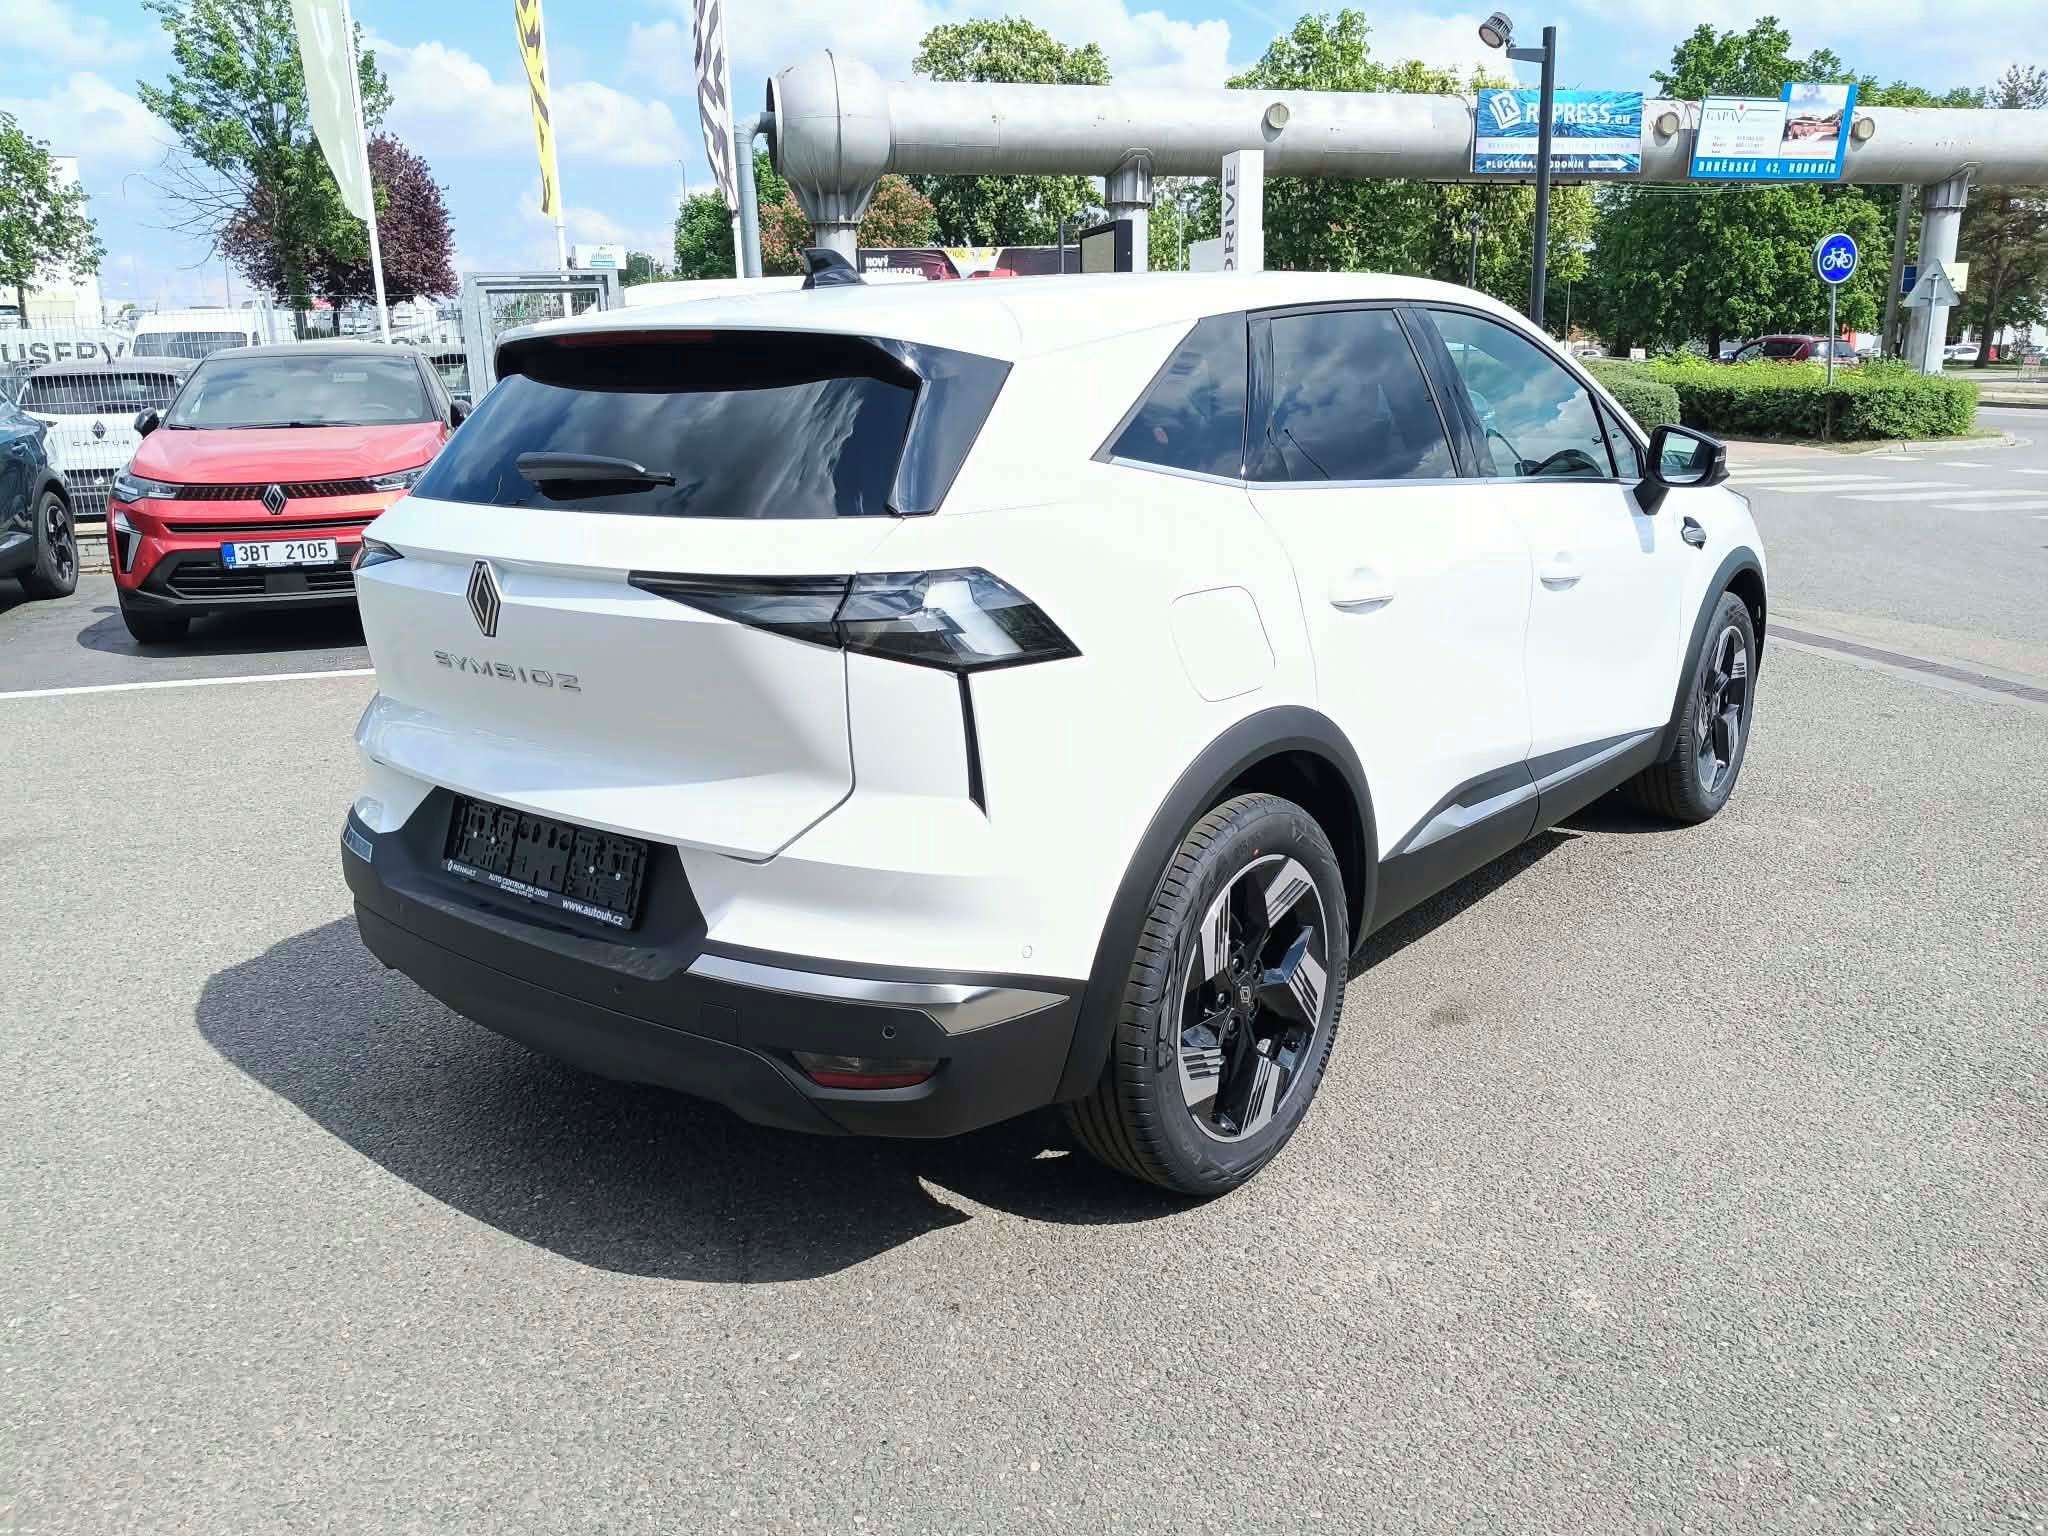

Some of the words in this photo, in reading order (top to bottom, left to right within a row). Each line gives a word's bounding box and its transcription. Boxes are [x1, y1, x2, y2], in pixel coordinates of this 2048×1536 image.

[1526, 102, 1631, 124] RPRESS.eu
[1550, 157, 1584, 169] ODONÍN
[1788, 161, 1837, 174] HODONÍN
[865, 254, 889, 267] NOVÝ
[239, 544, 270, 562] 3BT
[285, 542, 329, 560] 2105
[433, 650, 581, 691] SYMBIOZ
[453, 864, 477, 877] RENAULT
[562, 898, 624, 926] www.autouh.cz
